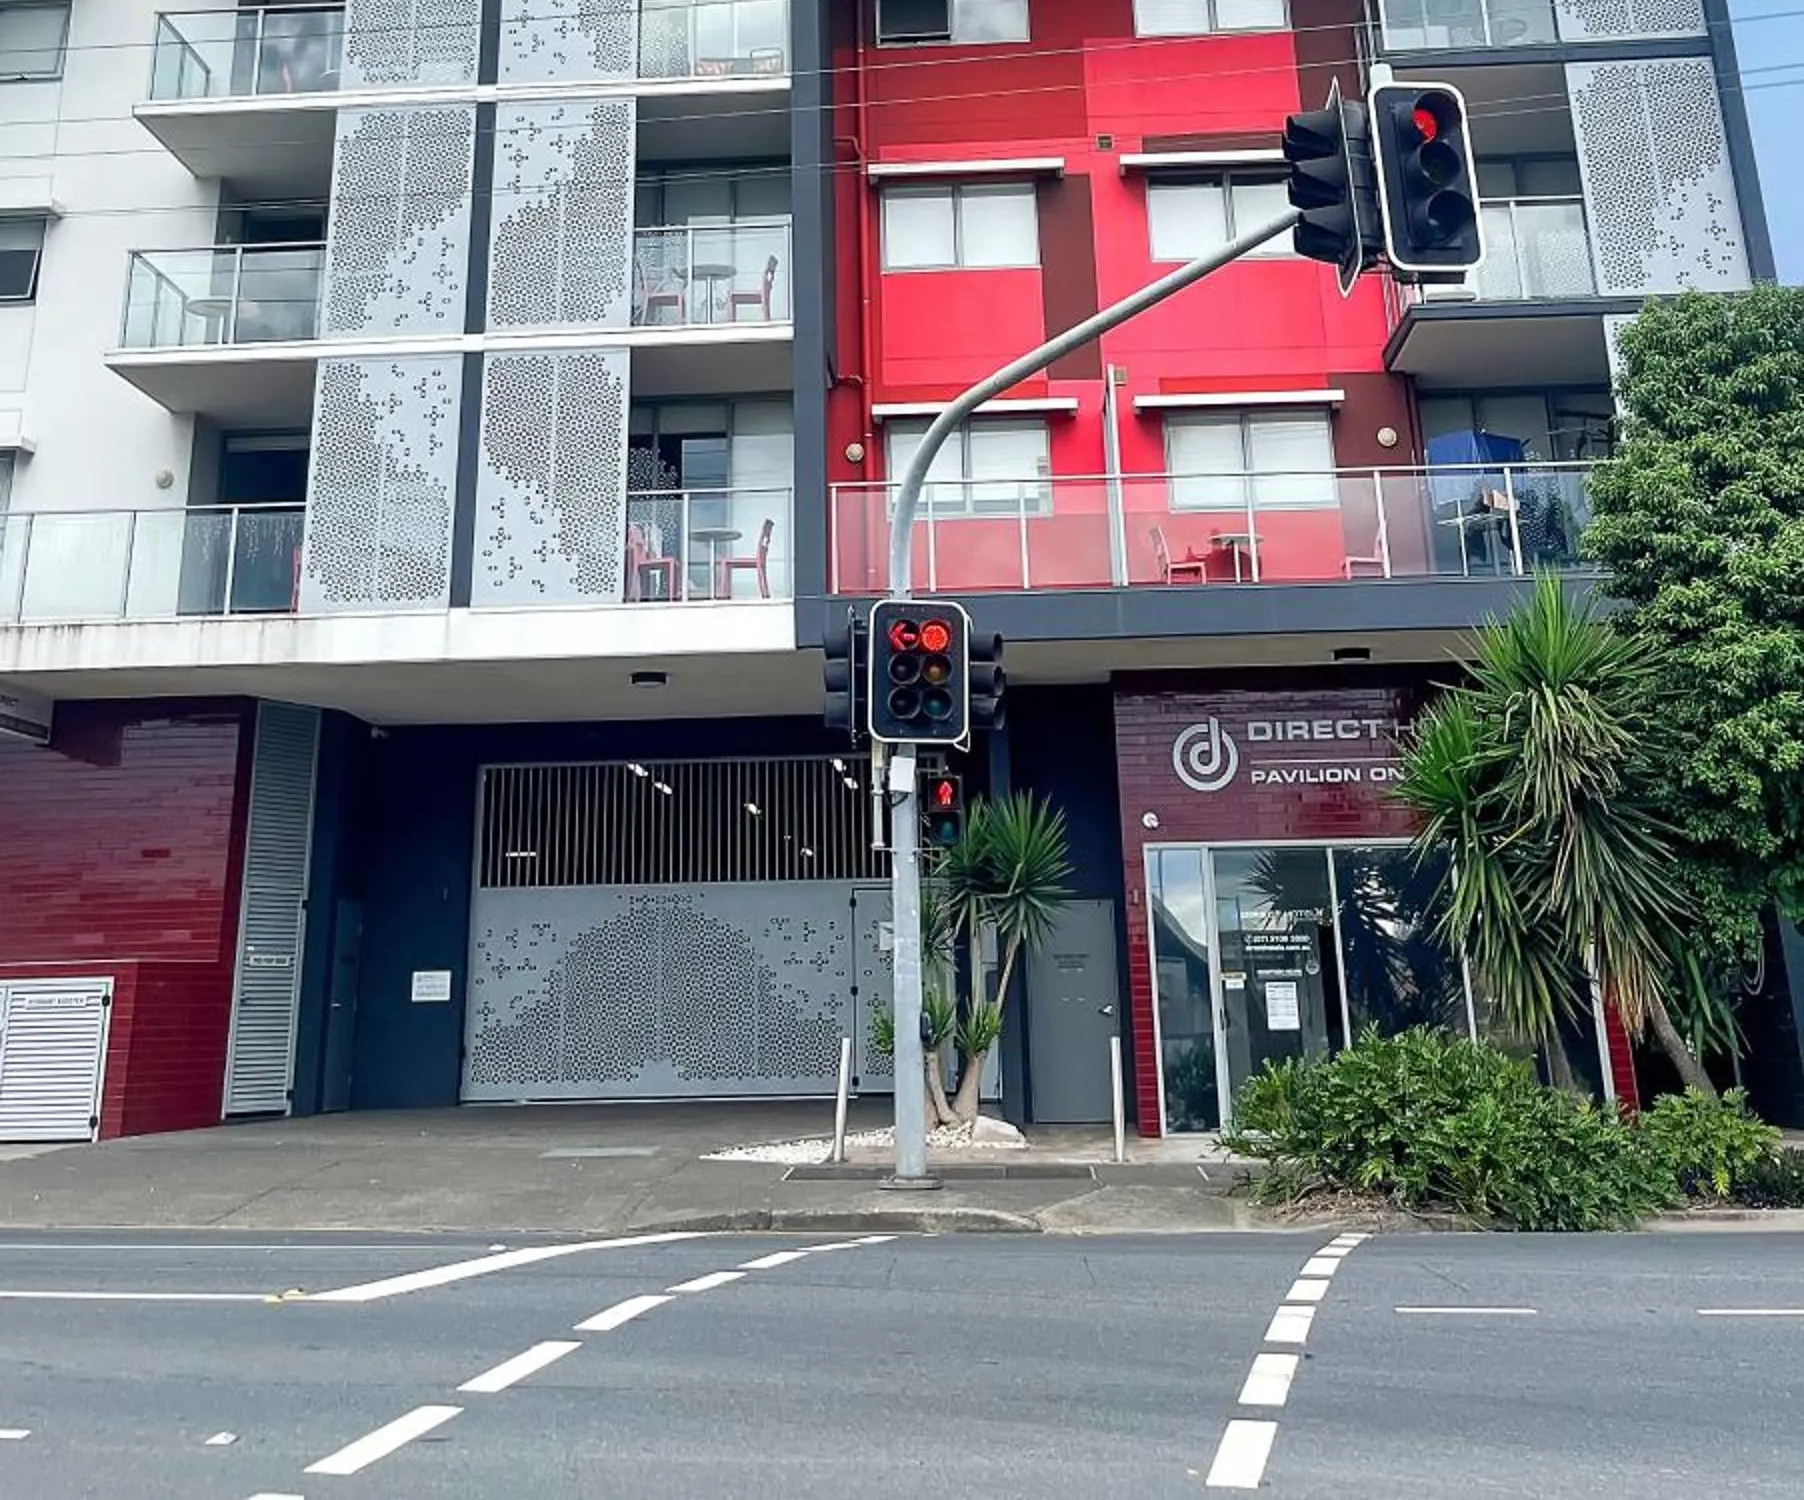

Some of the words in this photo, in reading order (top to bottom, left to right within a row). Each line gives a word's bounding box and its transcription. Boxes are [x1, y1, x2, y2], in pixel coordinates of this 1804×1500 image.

[1247, 719, 1383, 741] DIRECT
[1251, 767, 1361, 784] PAVILION
[1369, 766, 1405, 781] ON
